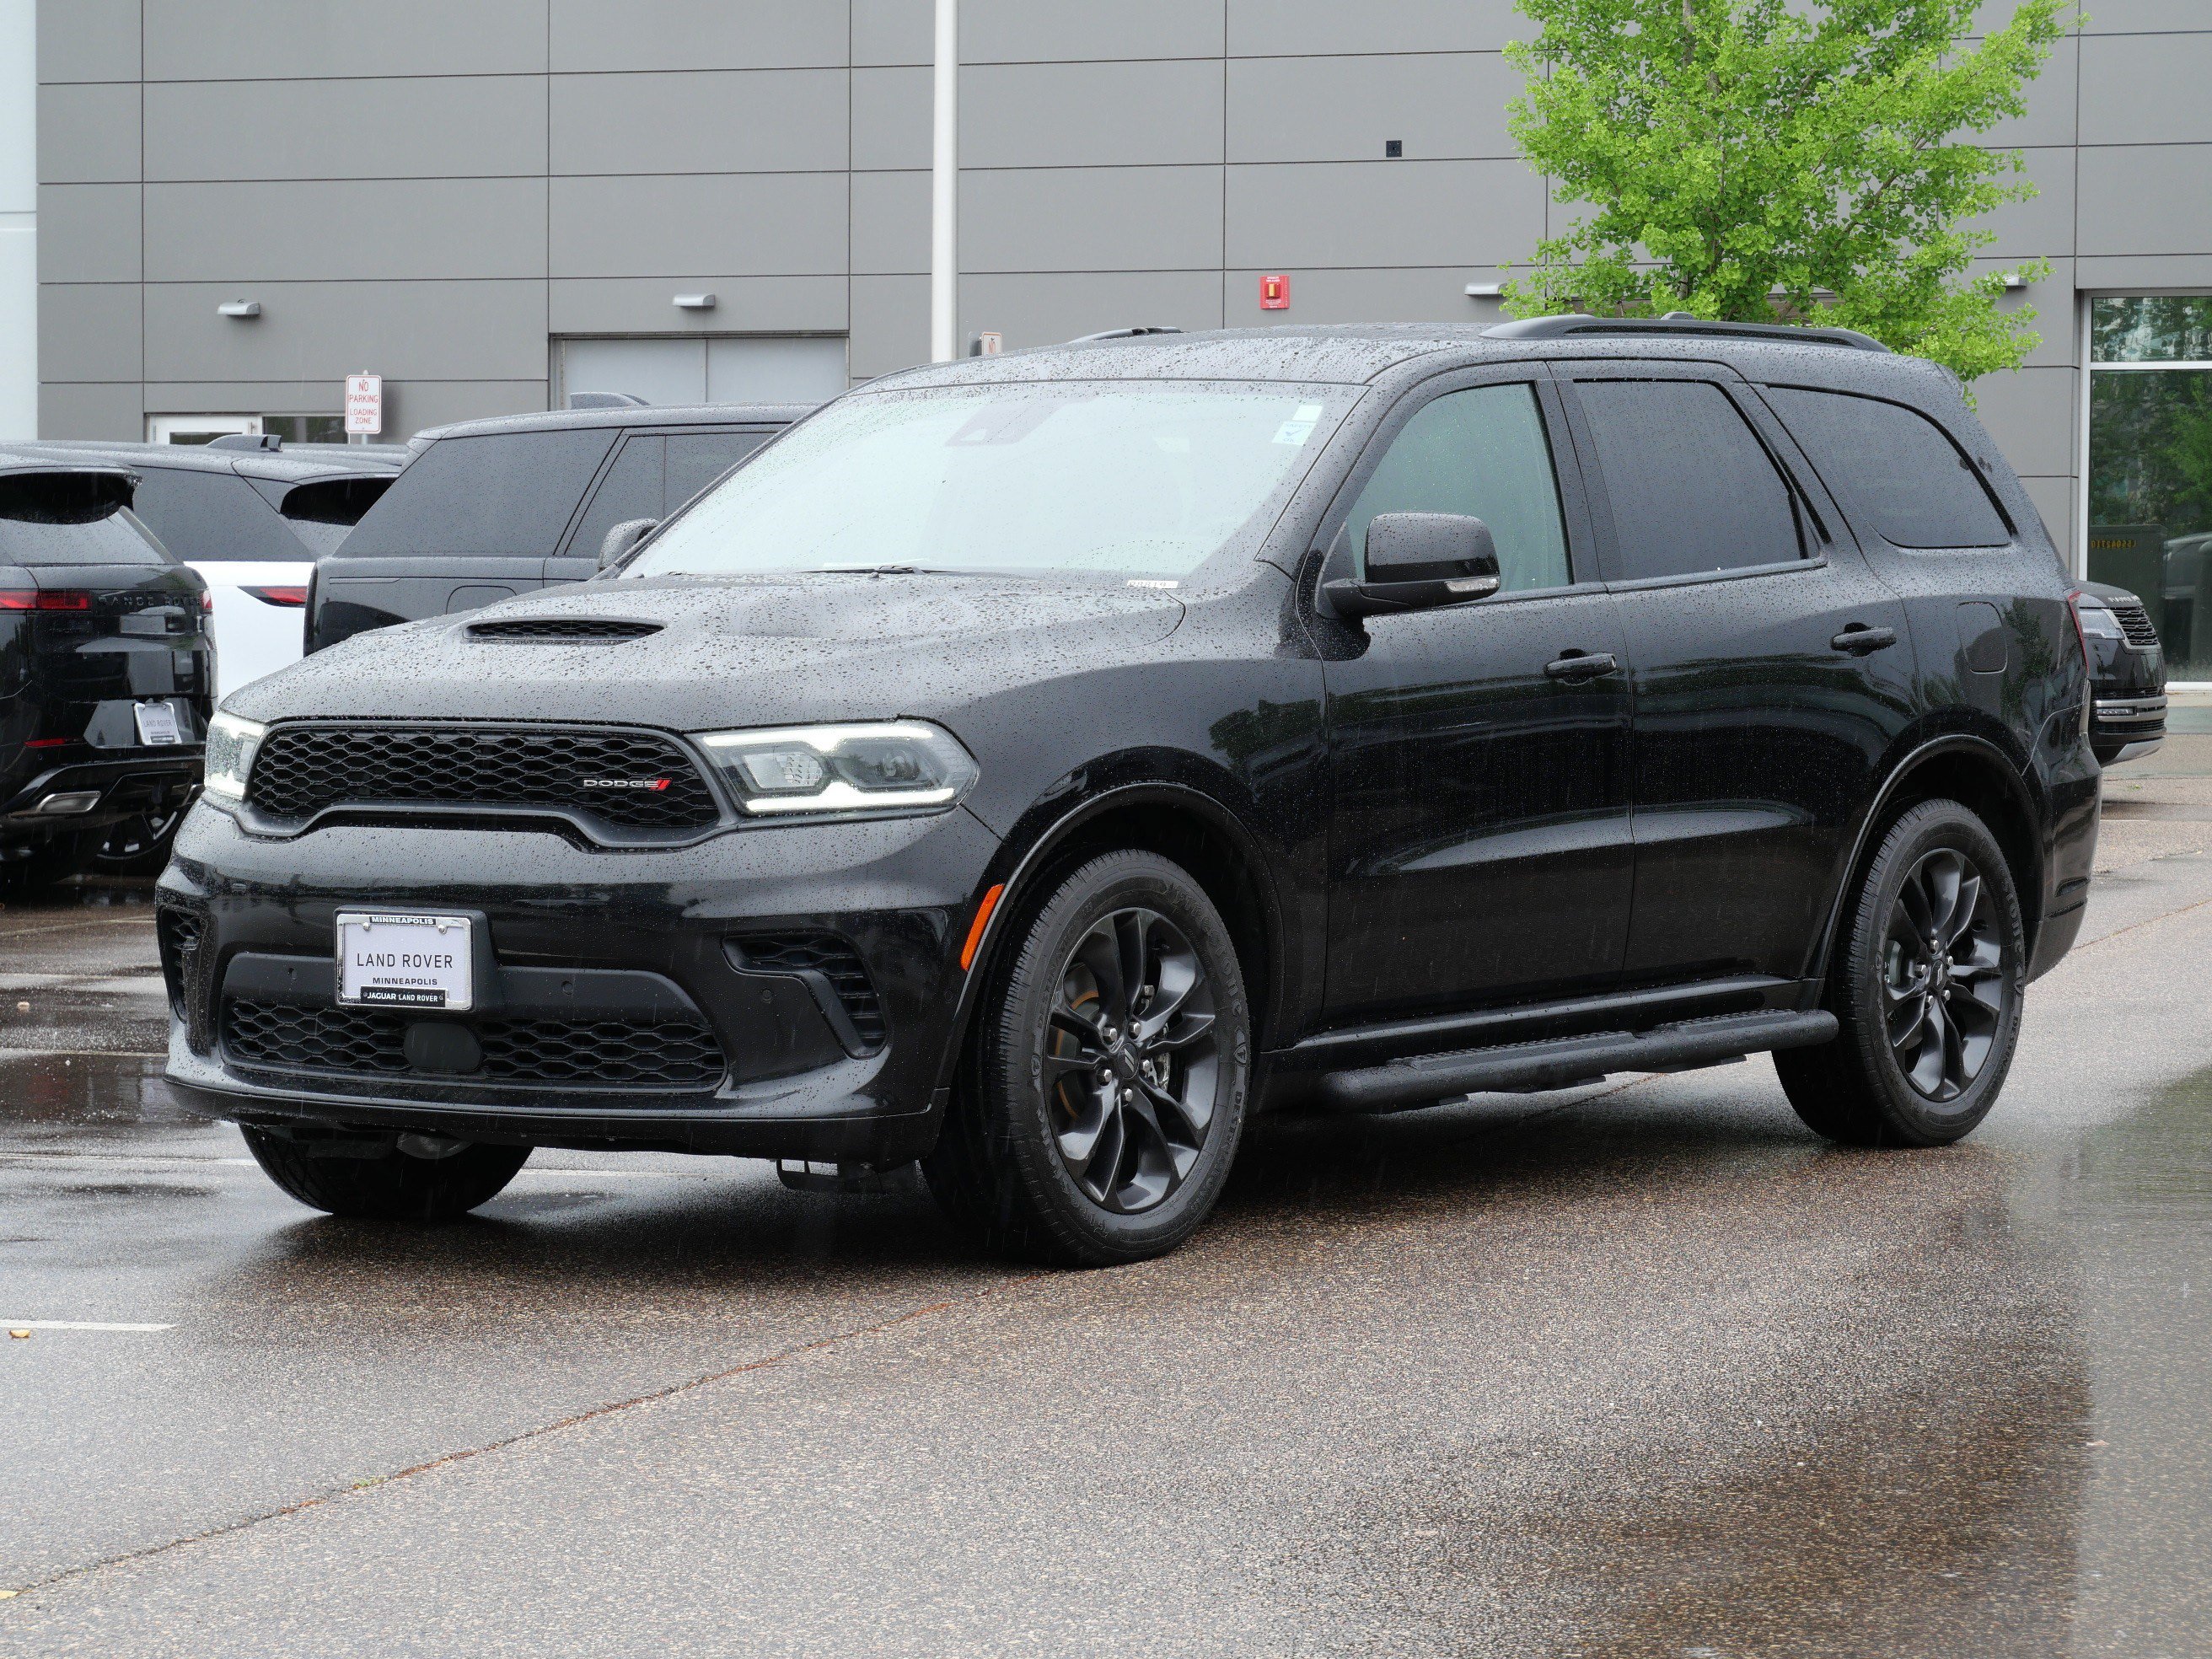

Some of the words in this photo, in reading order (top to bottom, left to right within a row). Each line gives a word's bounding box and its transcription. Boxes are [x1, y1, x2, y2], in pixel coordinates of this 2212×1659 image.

[358, 381, 369, 392] NO
[349, 394, 379, 403] PARKING
[98, 595, 154, 606] RANGE
[143, 719, 157, 727] LAND
[583, 779, 659, 787] DODGE
[371, 916, 434, 925] MINNEAPOLIS
[357, 953, 395, 967] LAND
[402, 954, 453, 968] ROVER
[373, 977, 438, 985] MINNEAPOLIS
